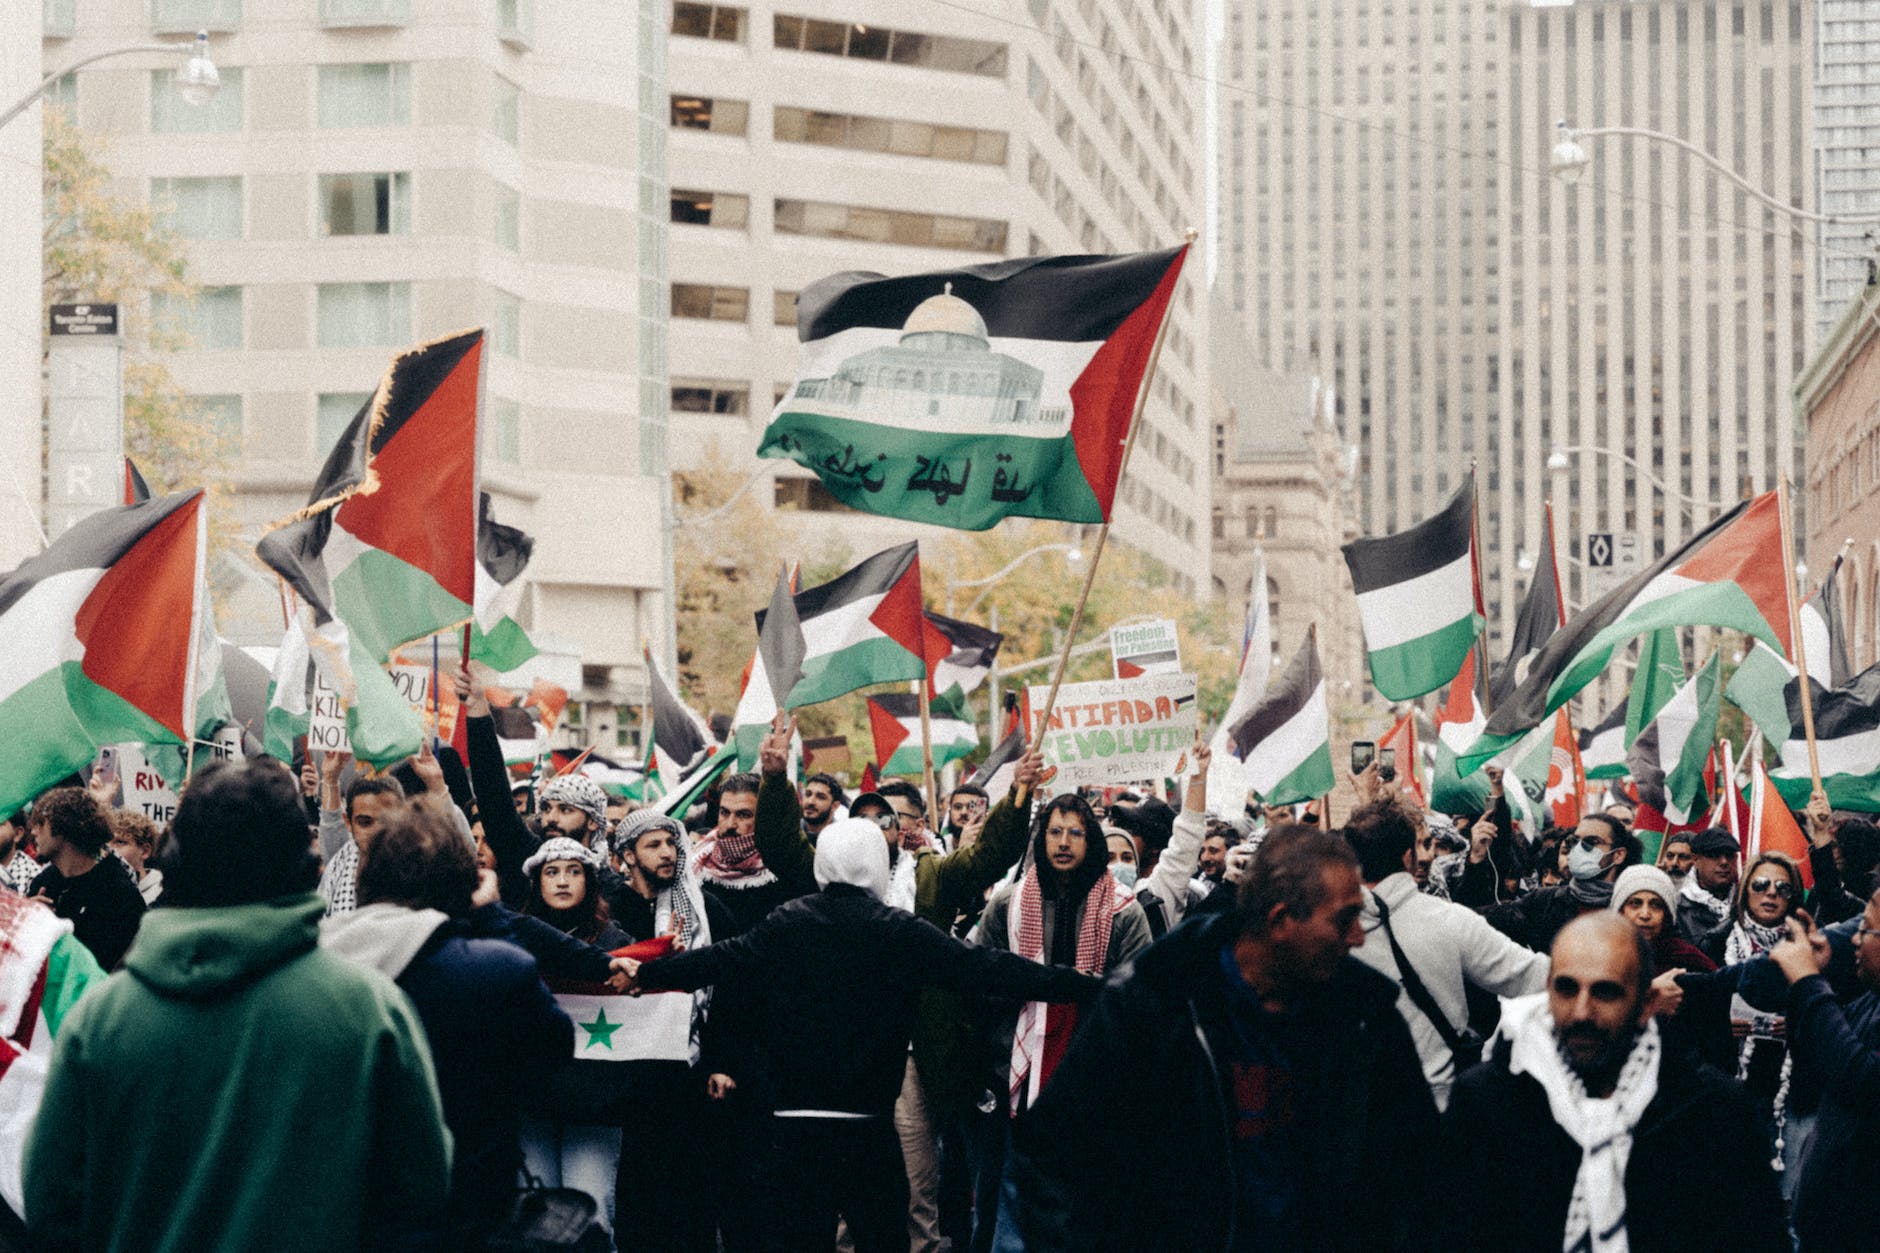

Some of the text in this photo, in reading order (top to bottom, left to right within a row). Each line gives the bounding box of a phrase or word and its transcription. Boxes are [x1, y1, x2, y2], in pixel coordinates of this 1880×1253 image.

[1114, 626, 1166, 644] Freedom
[315, 696, 345, 719] KIL
[1033, 695, 1171, 731] INTIFADA
[312, 725, 349, 748] NOT
[135, 771, 172, 791] RIV
[1064, 761, 1166, 780] FREE PALESTINE
